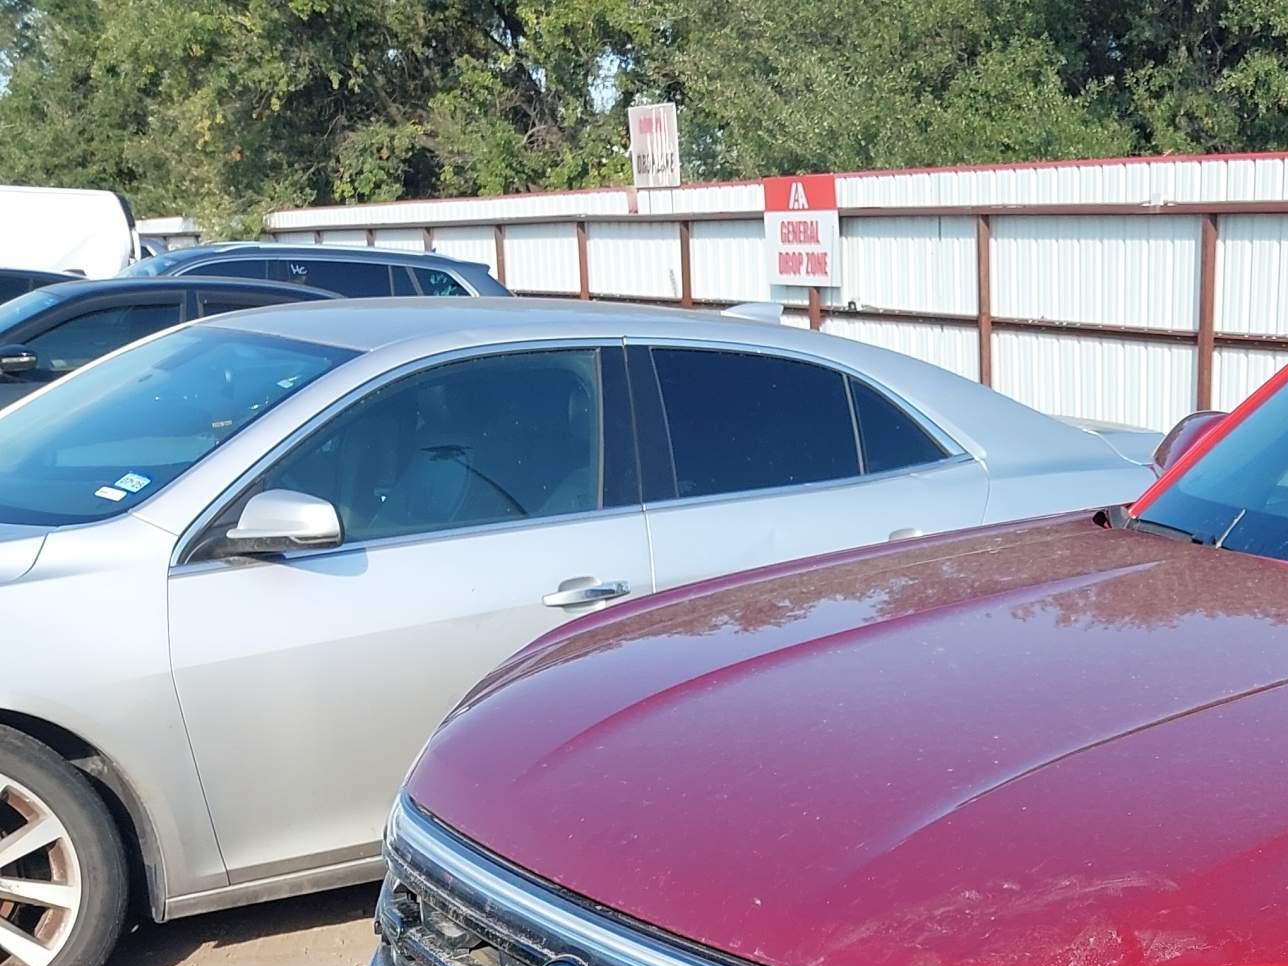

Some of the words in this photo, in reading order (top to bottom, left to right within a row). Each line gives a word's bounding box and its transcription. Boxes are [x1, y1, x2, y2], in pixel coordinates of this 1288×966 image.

[780, 220, 820, 244] GENERAL
[778, 251, 804, 275] DROP
[805, 251, 829, 276] ZONE
